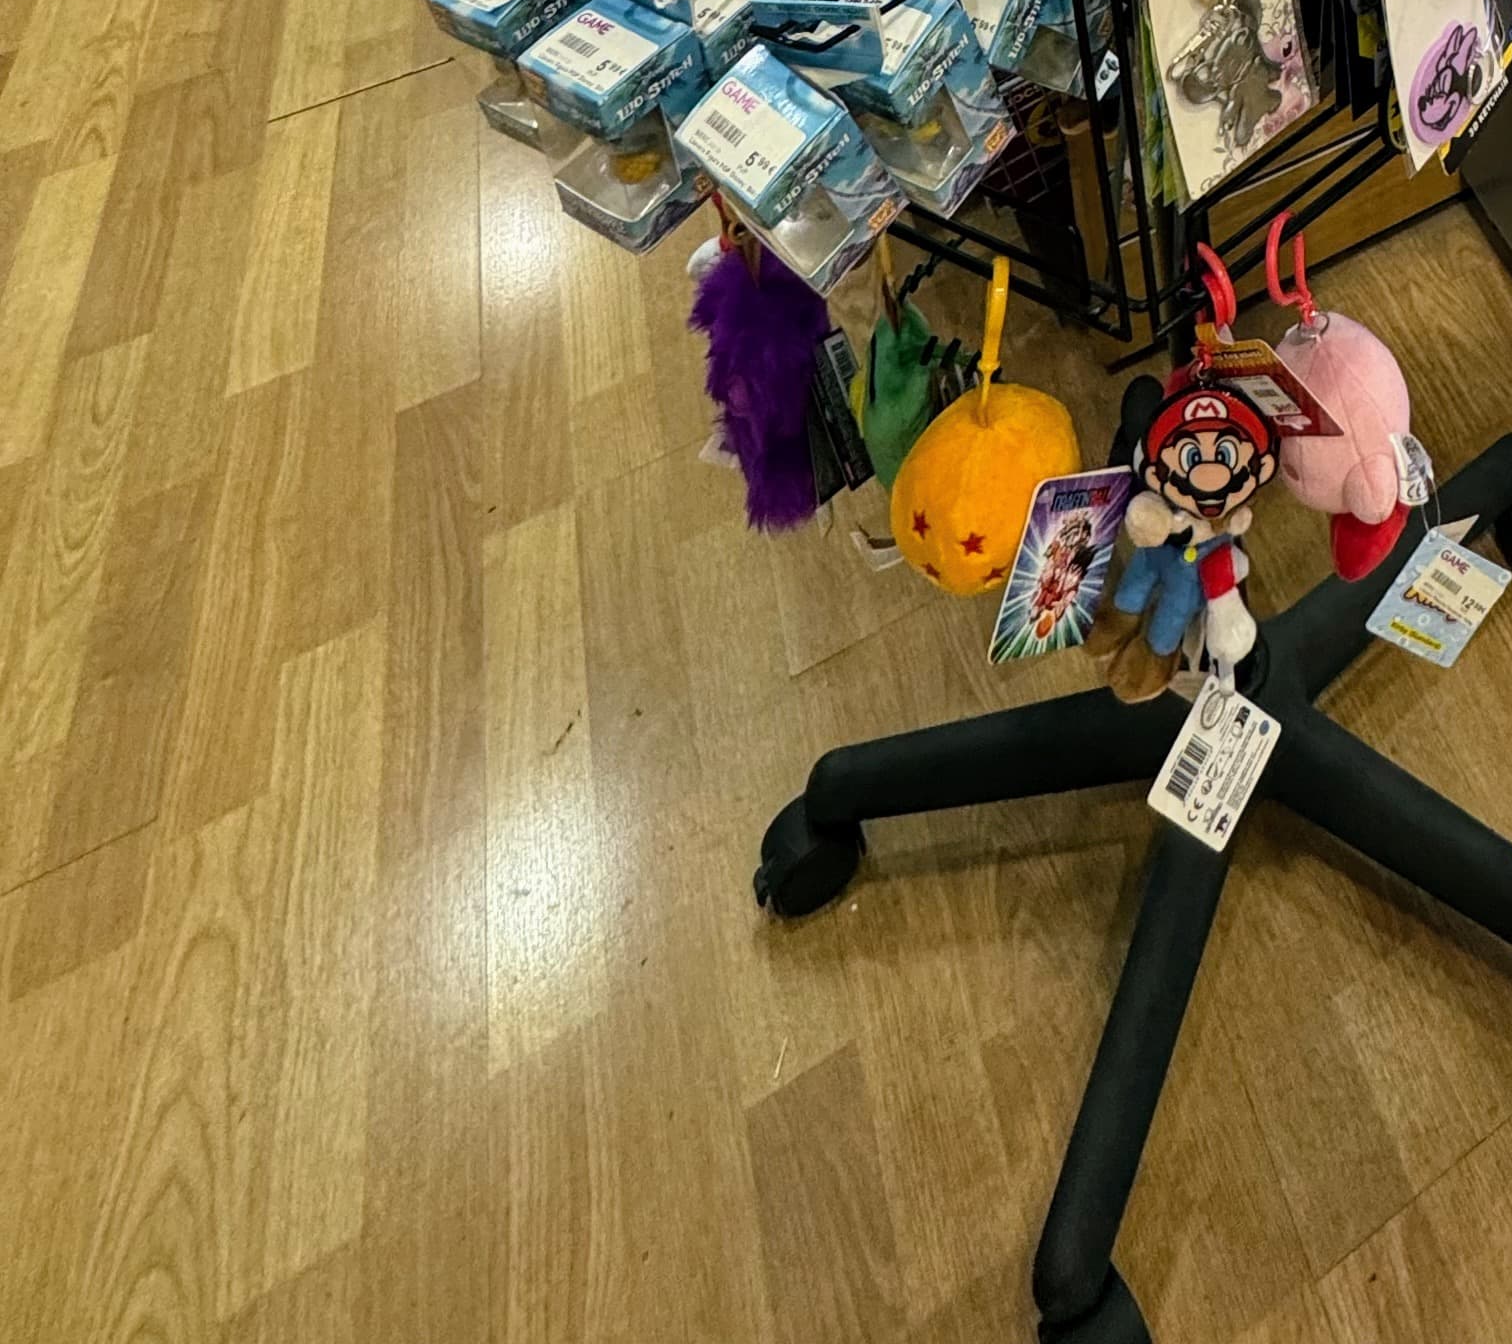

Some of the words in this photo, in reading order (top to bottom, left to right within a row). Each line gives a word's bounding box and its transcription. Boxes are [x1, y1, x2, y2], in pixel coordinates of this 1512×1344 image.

[578, 11, 612, 35] GAME
[721, 79, 759, 114] GAME
[1478, 78, 1509, 125] KEYCHAIN
[1441, 550, 1470, 574] GAME
